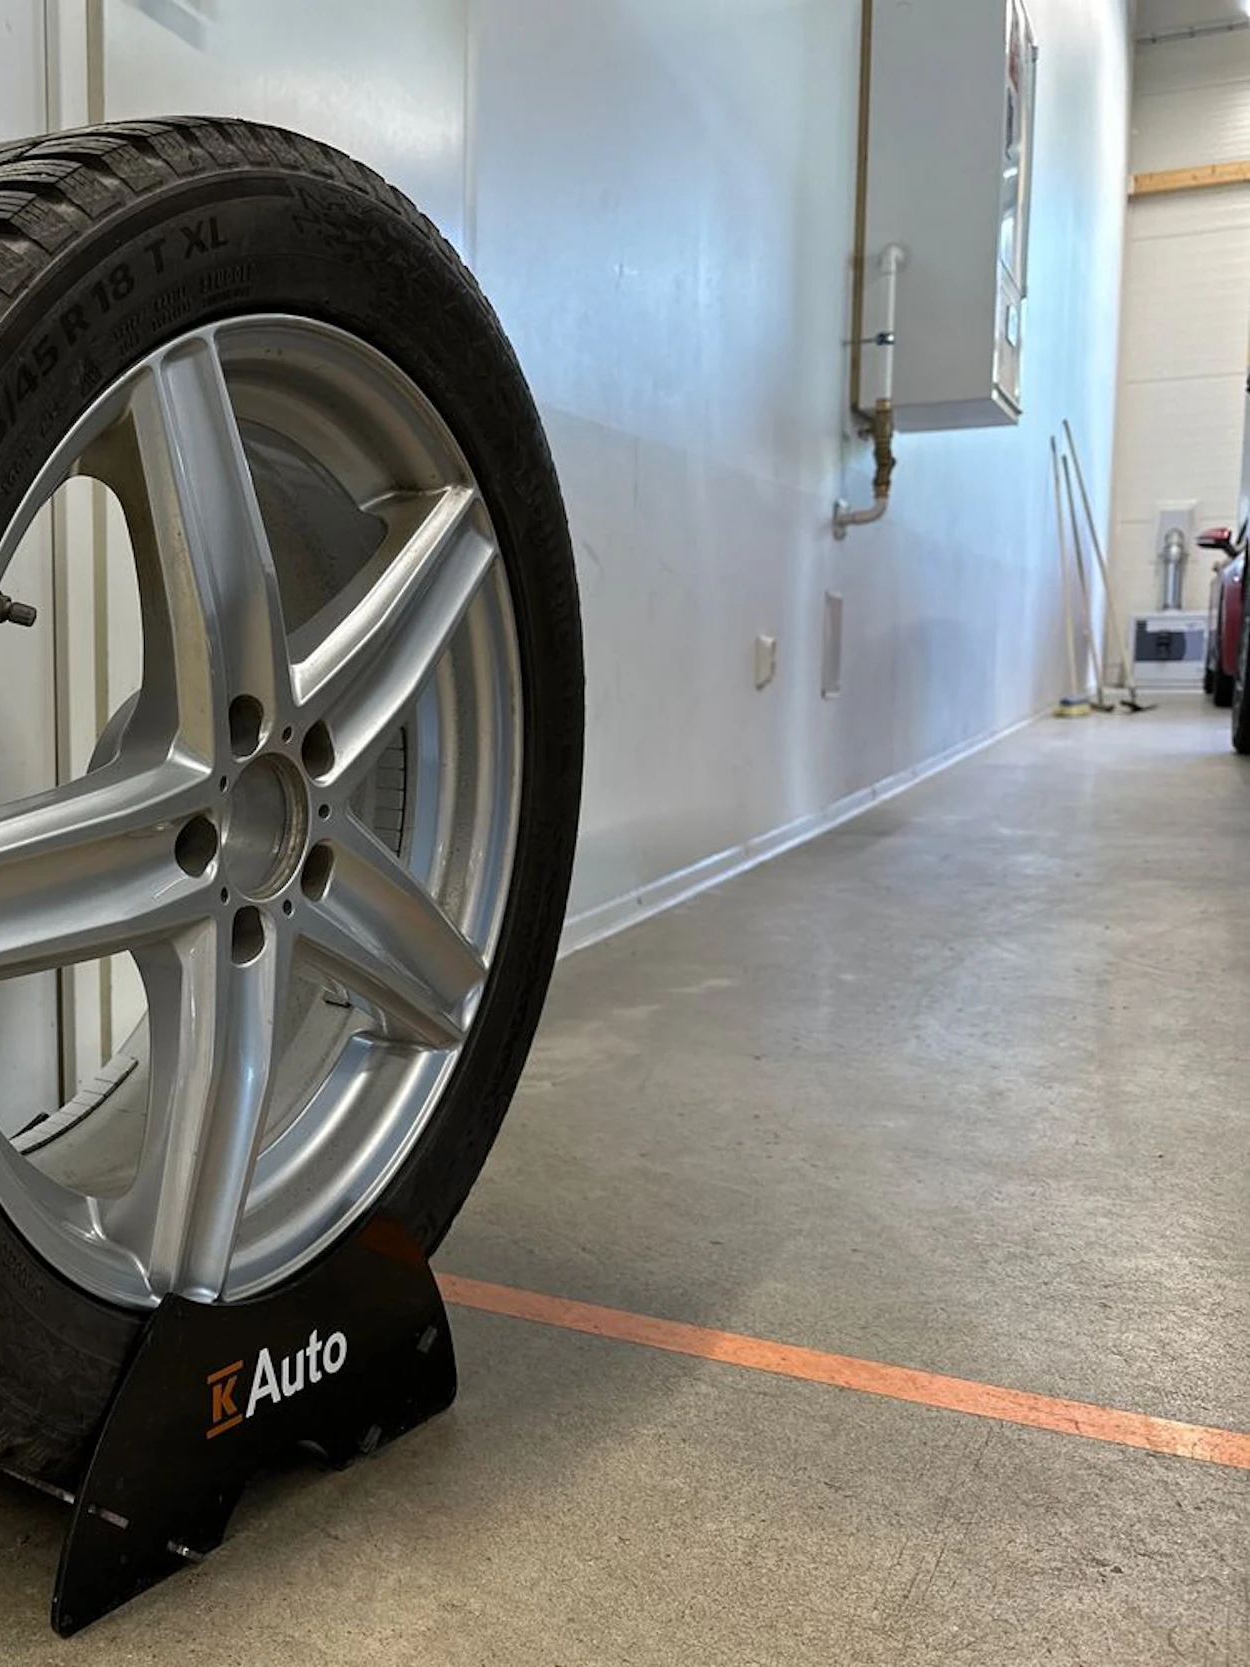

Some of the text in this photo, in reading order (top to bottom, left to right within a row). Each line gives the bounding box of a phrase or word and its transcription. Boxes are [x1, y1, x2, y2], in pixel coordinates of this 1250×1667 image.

[59, 303, 91, 347] R
[91, 262, 136, 312] 18
[143, 236, 168, 275] T
[179, 215, 229, 259] XL
[245, 1328, 348, 1419] Auto
